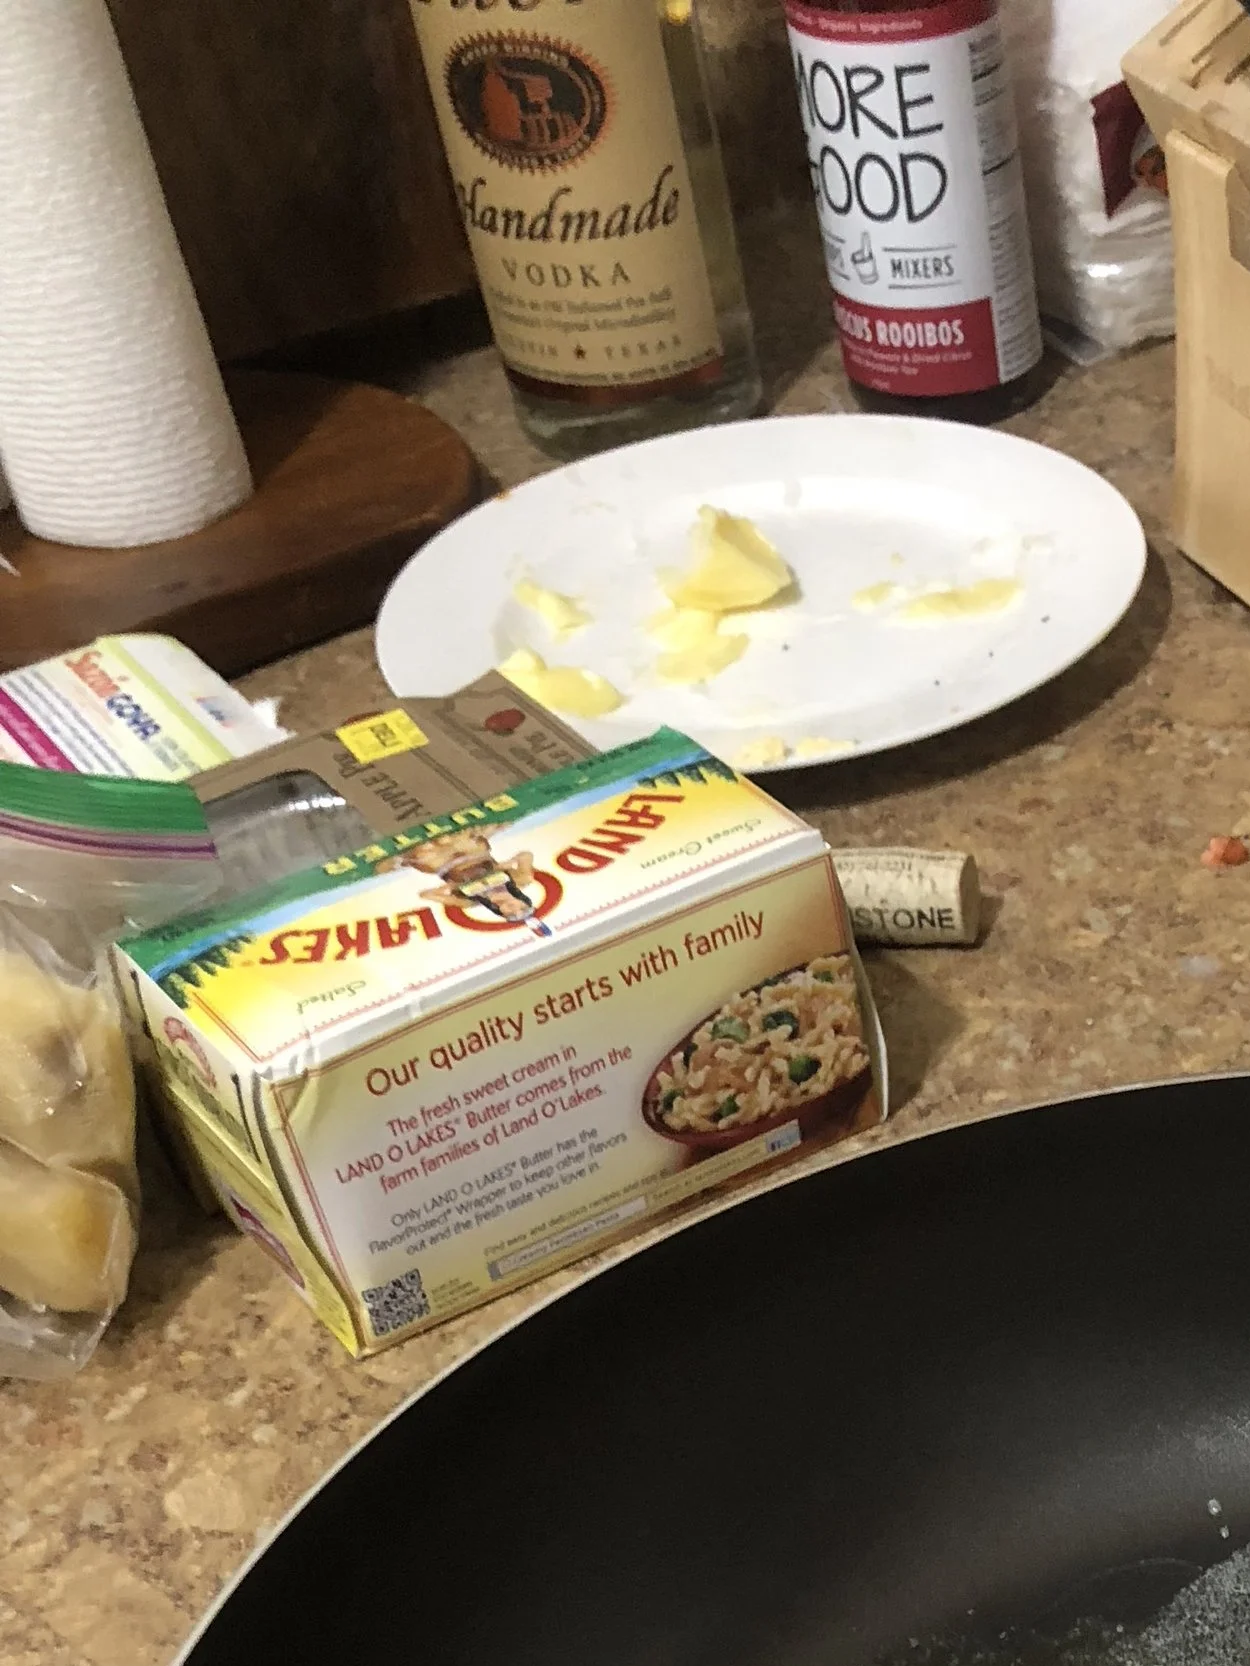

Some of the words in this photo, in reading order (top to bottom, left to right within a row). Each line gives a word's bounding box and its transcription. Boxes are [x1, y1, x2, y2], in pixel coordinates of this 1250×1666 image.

[457, 165, 680, 243] Handmade
[809, 146, 948, 223] OOD
[502, 257, 631, 289] VODKA
[890, 255, 955, 279] MIXERS
[875, 319, 965, 348] ROOIBOS
[323, 794, 519, 875] BUTTER
[556, 793, 685, 874] LAND
[641, 841, 701, 870] Cream
[707, 818, 761, 845] Sweet
[855, 907, 956, 930] STONE
[366, 1057, 420, 1097] Our
[429, 1010, 525, 1071] quality
[533, 975, 613, 1026] starts
[619, 945, 679, 988] with
[683, 910, 765, 961] family
[335, 1153, 384, 1184] LAND
[388, 1145, 404, 1163] O
[465, 1099, 512, 1130] Butter
[515, 1076, 567, 1107] comes
[568, 1058, 606, 1086] from
[608, 1045, 633, 1067] the
[387, 1117, 419, 1137] The
[420, 1097, 461, 1127] fresh
[463, 1075, 510, 1106] sweet
[512, 1053, 561, 1083] cream
[560, 1045, 577, 1061] in
[379, 1163, 420, 1195] farm
[419, 1138, 481, 1177] families
[483, 1124, 500, 1146] of
[499, 1106, 540, 1140] Land
[390, 1203, 422, 1230] Only
[422, 1187, 458, 1217] LAND
[461, 1180, 475, 1196] O
[519, 1147, 553, 1170] Butter
[556, 1136, 577, 1153] has
[578, 1127, 598, 1145] the
[454, 1184, 508, 1218] Wrapper
[509, 1177, 523, 1193] to
[524, 1163, 555, 1187] keep
[555, 1147, 586, 1172] other
[587, 1130, 628, 1159] flavors
[405, 1240, 427, 1257] out
[429, 1228, 451, 1248] and
[453, 1215, 474, 1236] the
[475, 1201, 504, 1228] fresh
[506, 1188, 534, 1211] taste
[535, 1179, 560, 1199] you
[560, 1165, 588, 1186] love
